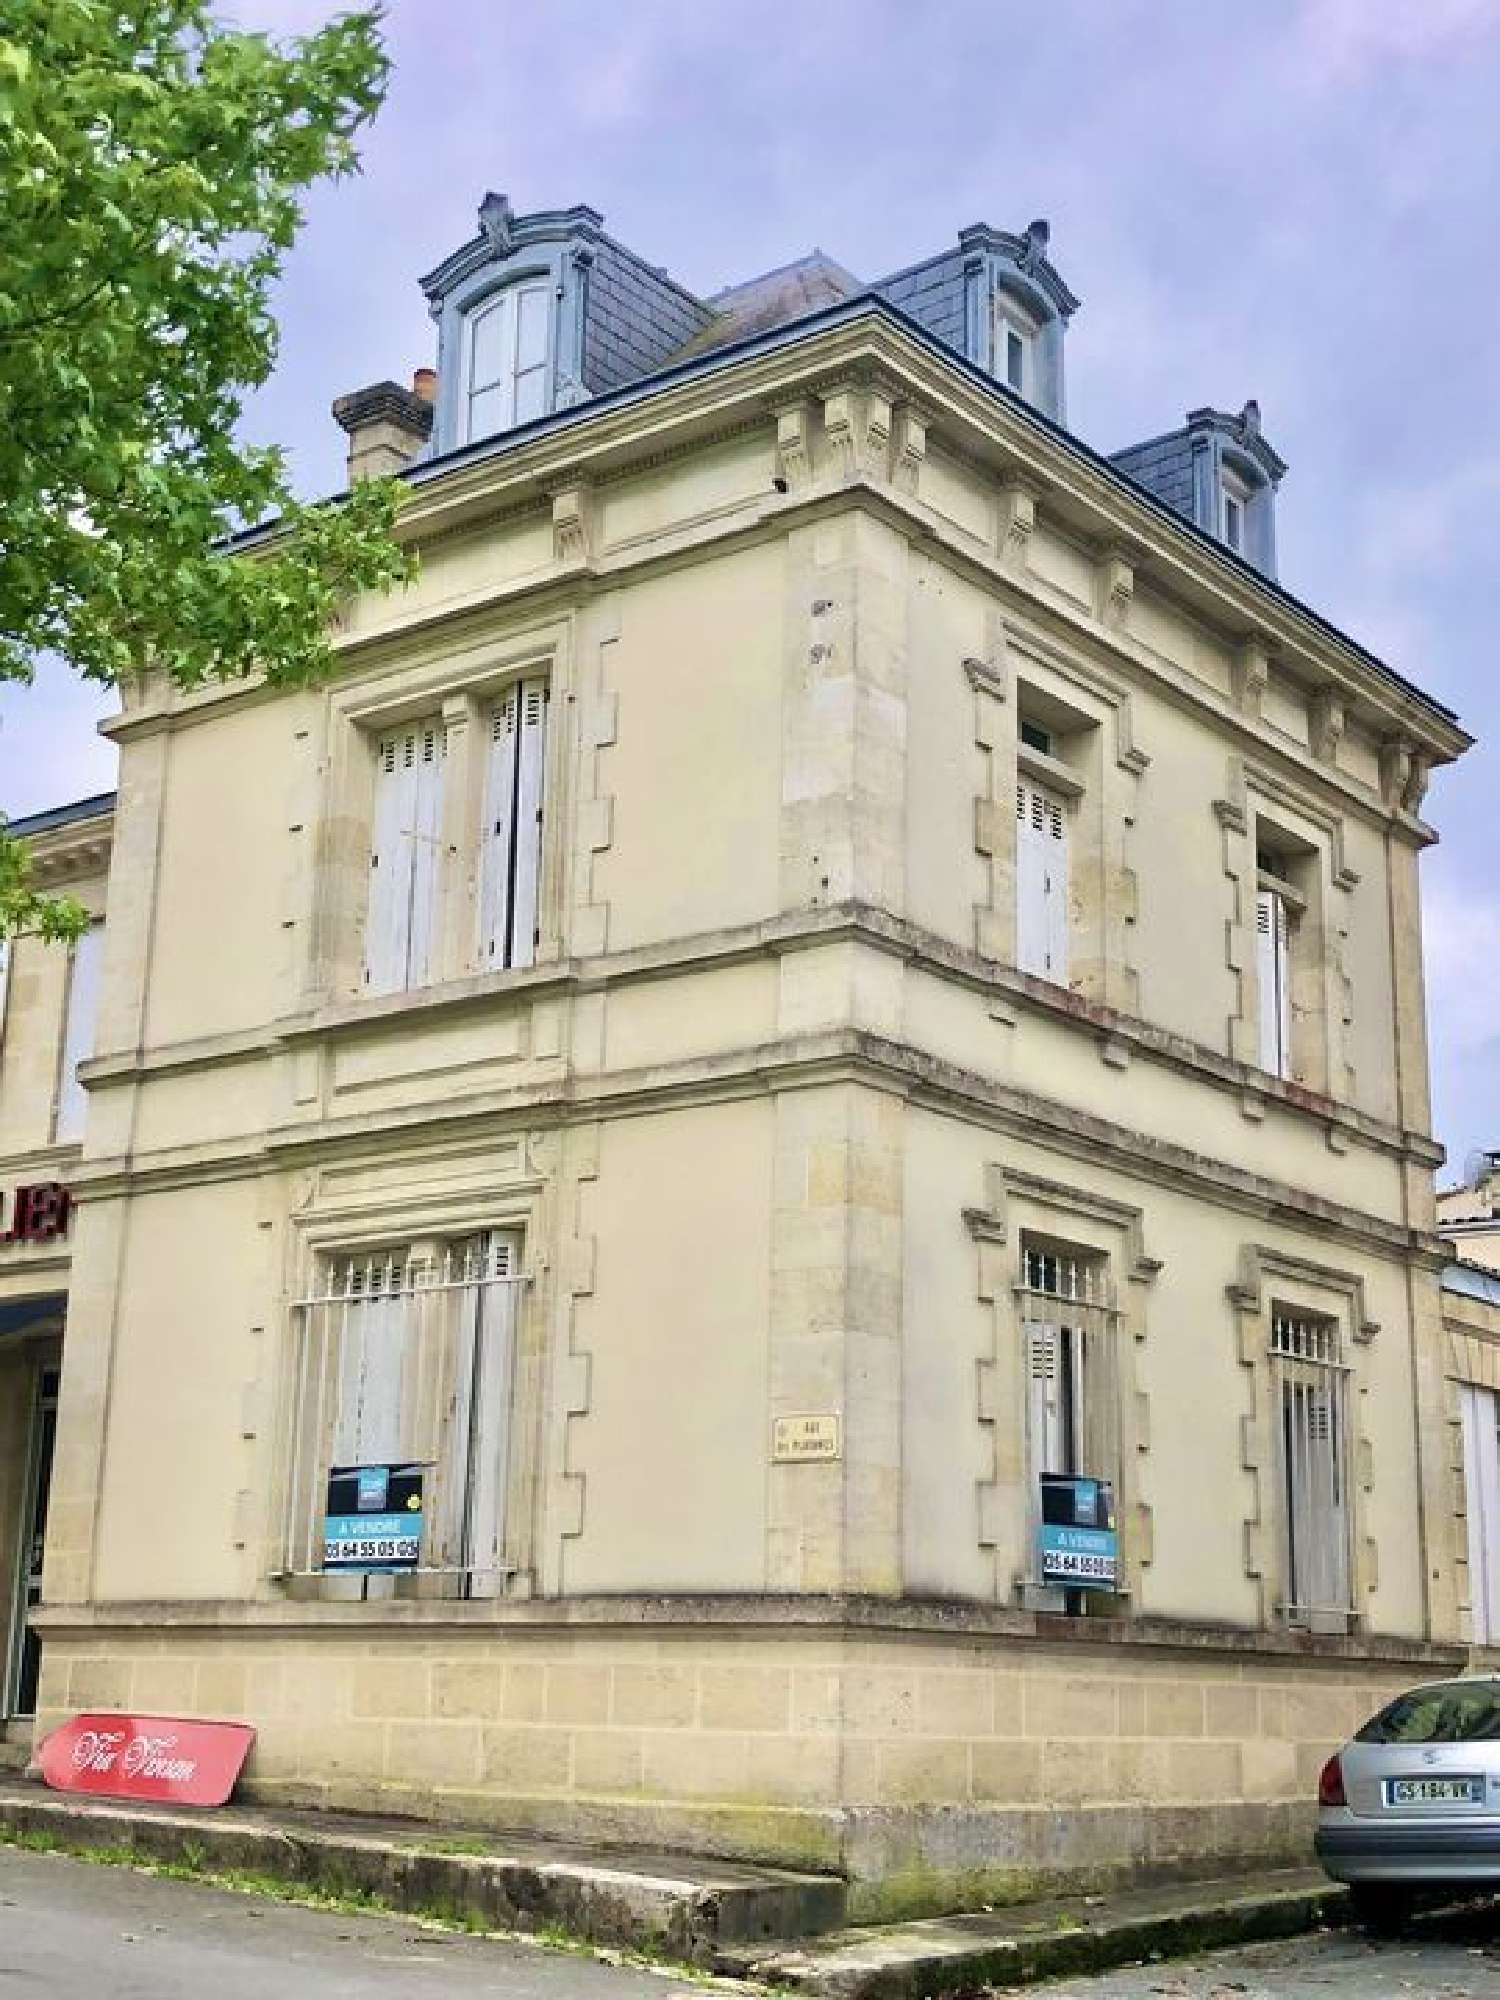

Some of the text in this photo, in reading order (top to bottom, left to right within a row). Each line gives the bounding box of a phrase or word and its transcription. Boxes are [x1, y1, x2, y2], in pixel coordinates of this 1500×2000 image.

[350, 1518, 401, 1534] VENDRE
[342, 1543, 357, 1557] 64
[360, 1542, 376, 1557] 55
[378, 1541, 394, 1556] 05
